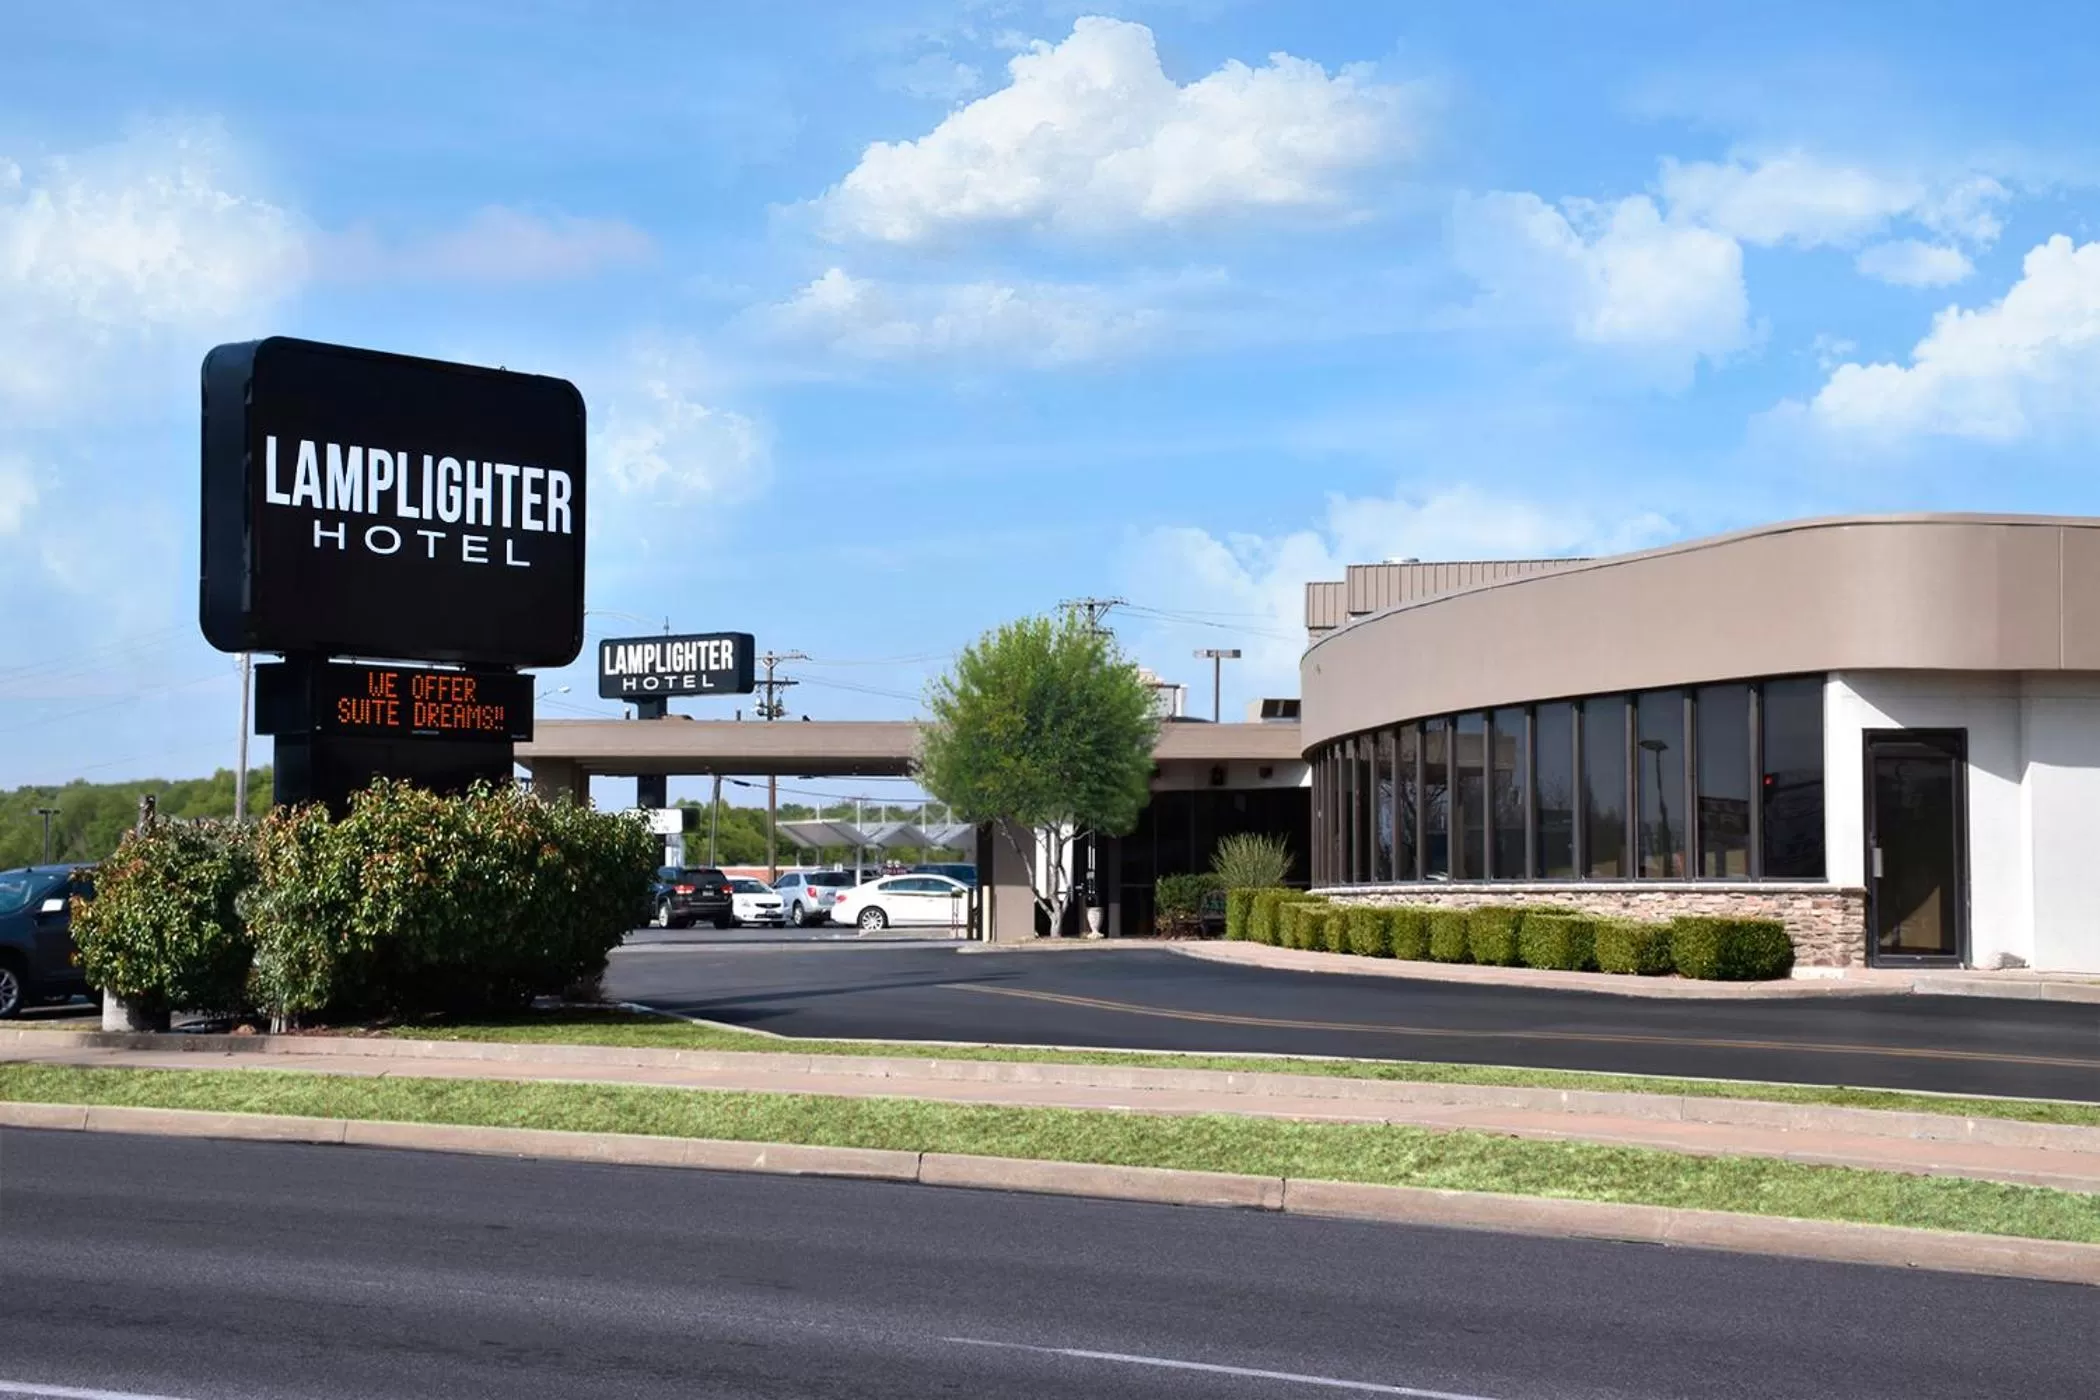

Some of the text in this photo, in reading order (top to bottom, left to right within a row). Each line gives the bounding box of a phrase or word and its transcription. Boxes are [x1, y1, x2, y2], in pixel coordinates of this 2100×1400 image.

[265, 435, 572, 534] LAMPLIGHTER
[313, 519, 531, 567] HOTEL
[604, 640, 734, 676] LAMPLIGHTER
[368, 672, 476, 702] WE OFFER
[622, 674, 715, 691] HOTEL
[338, 698, 504, 730] SUITE DREAMS!!
